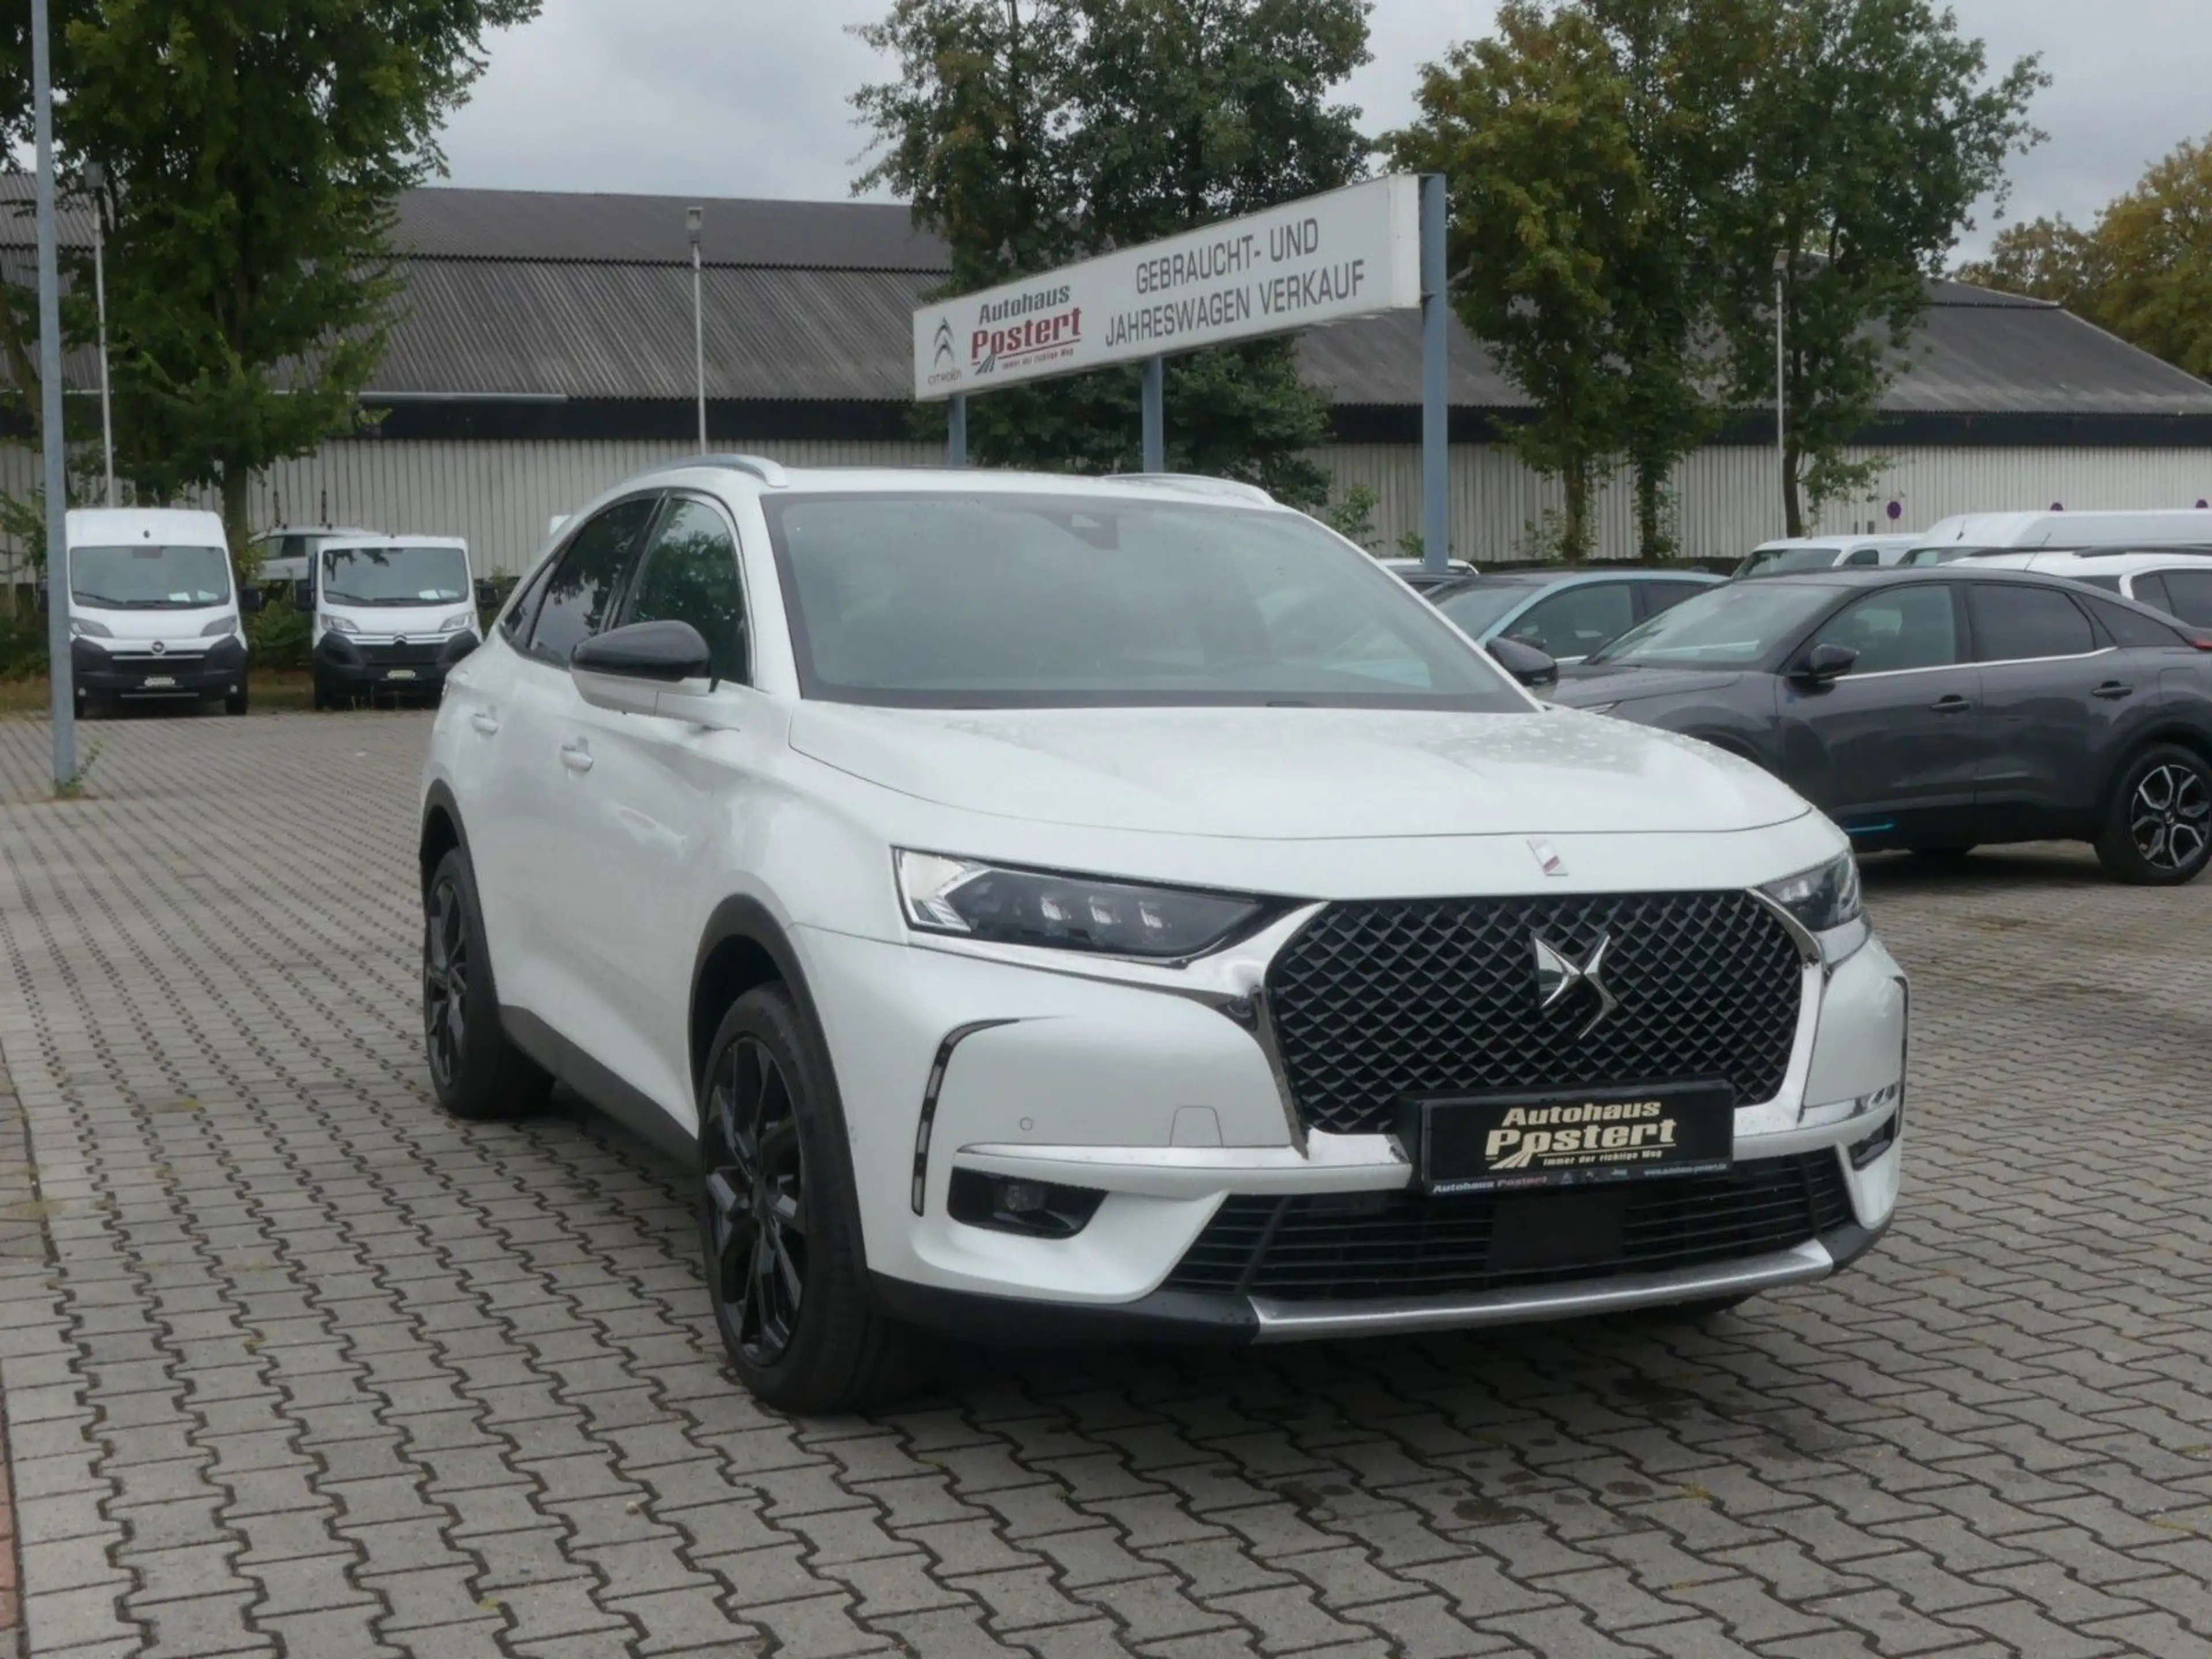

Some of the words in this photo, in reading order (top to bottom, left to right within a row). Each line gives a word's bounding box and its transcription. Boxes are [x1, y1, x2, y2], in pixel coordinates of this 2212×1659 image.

[1135, 234, 1261, 294] GEBRAUCHT-
[1270, 218, 1319, 263] UND
[978, 285, 1071, 325] Autohaus
[1105, 286, 1250, 347] JAHRESWAGEN
[1259, 259, 1365, 315] VERKAUF
[971, 306, 1083, 361] Postert
[1485, 1118, 1677, 1157] Postert
[1501, 1101, 1662, 1127] Autohaus
